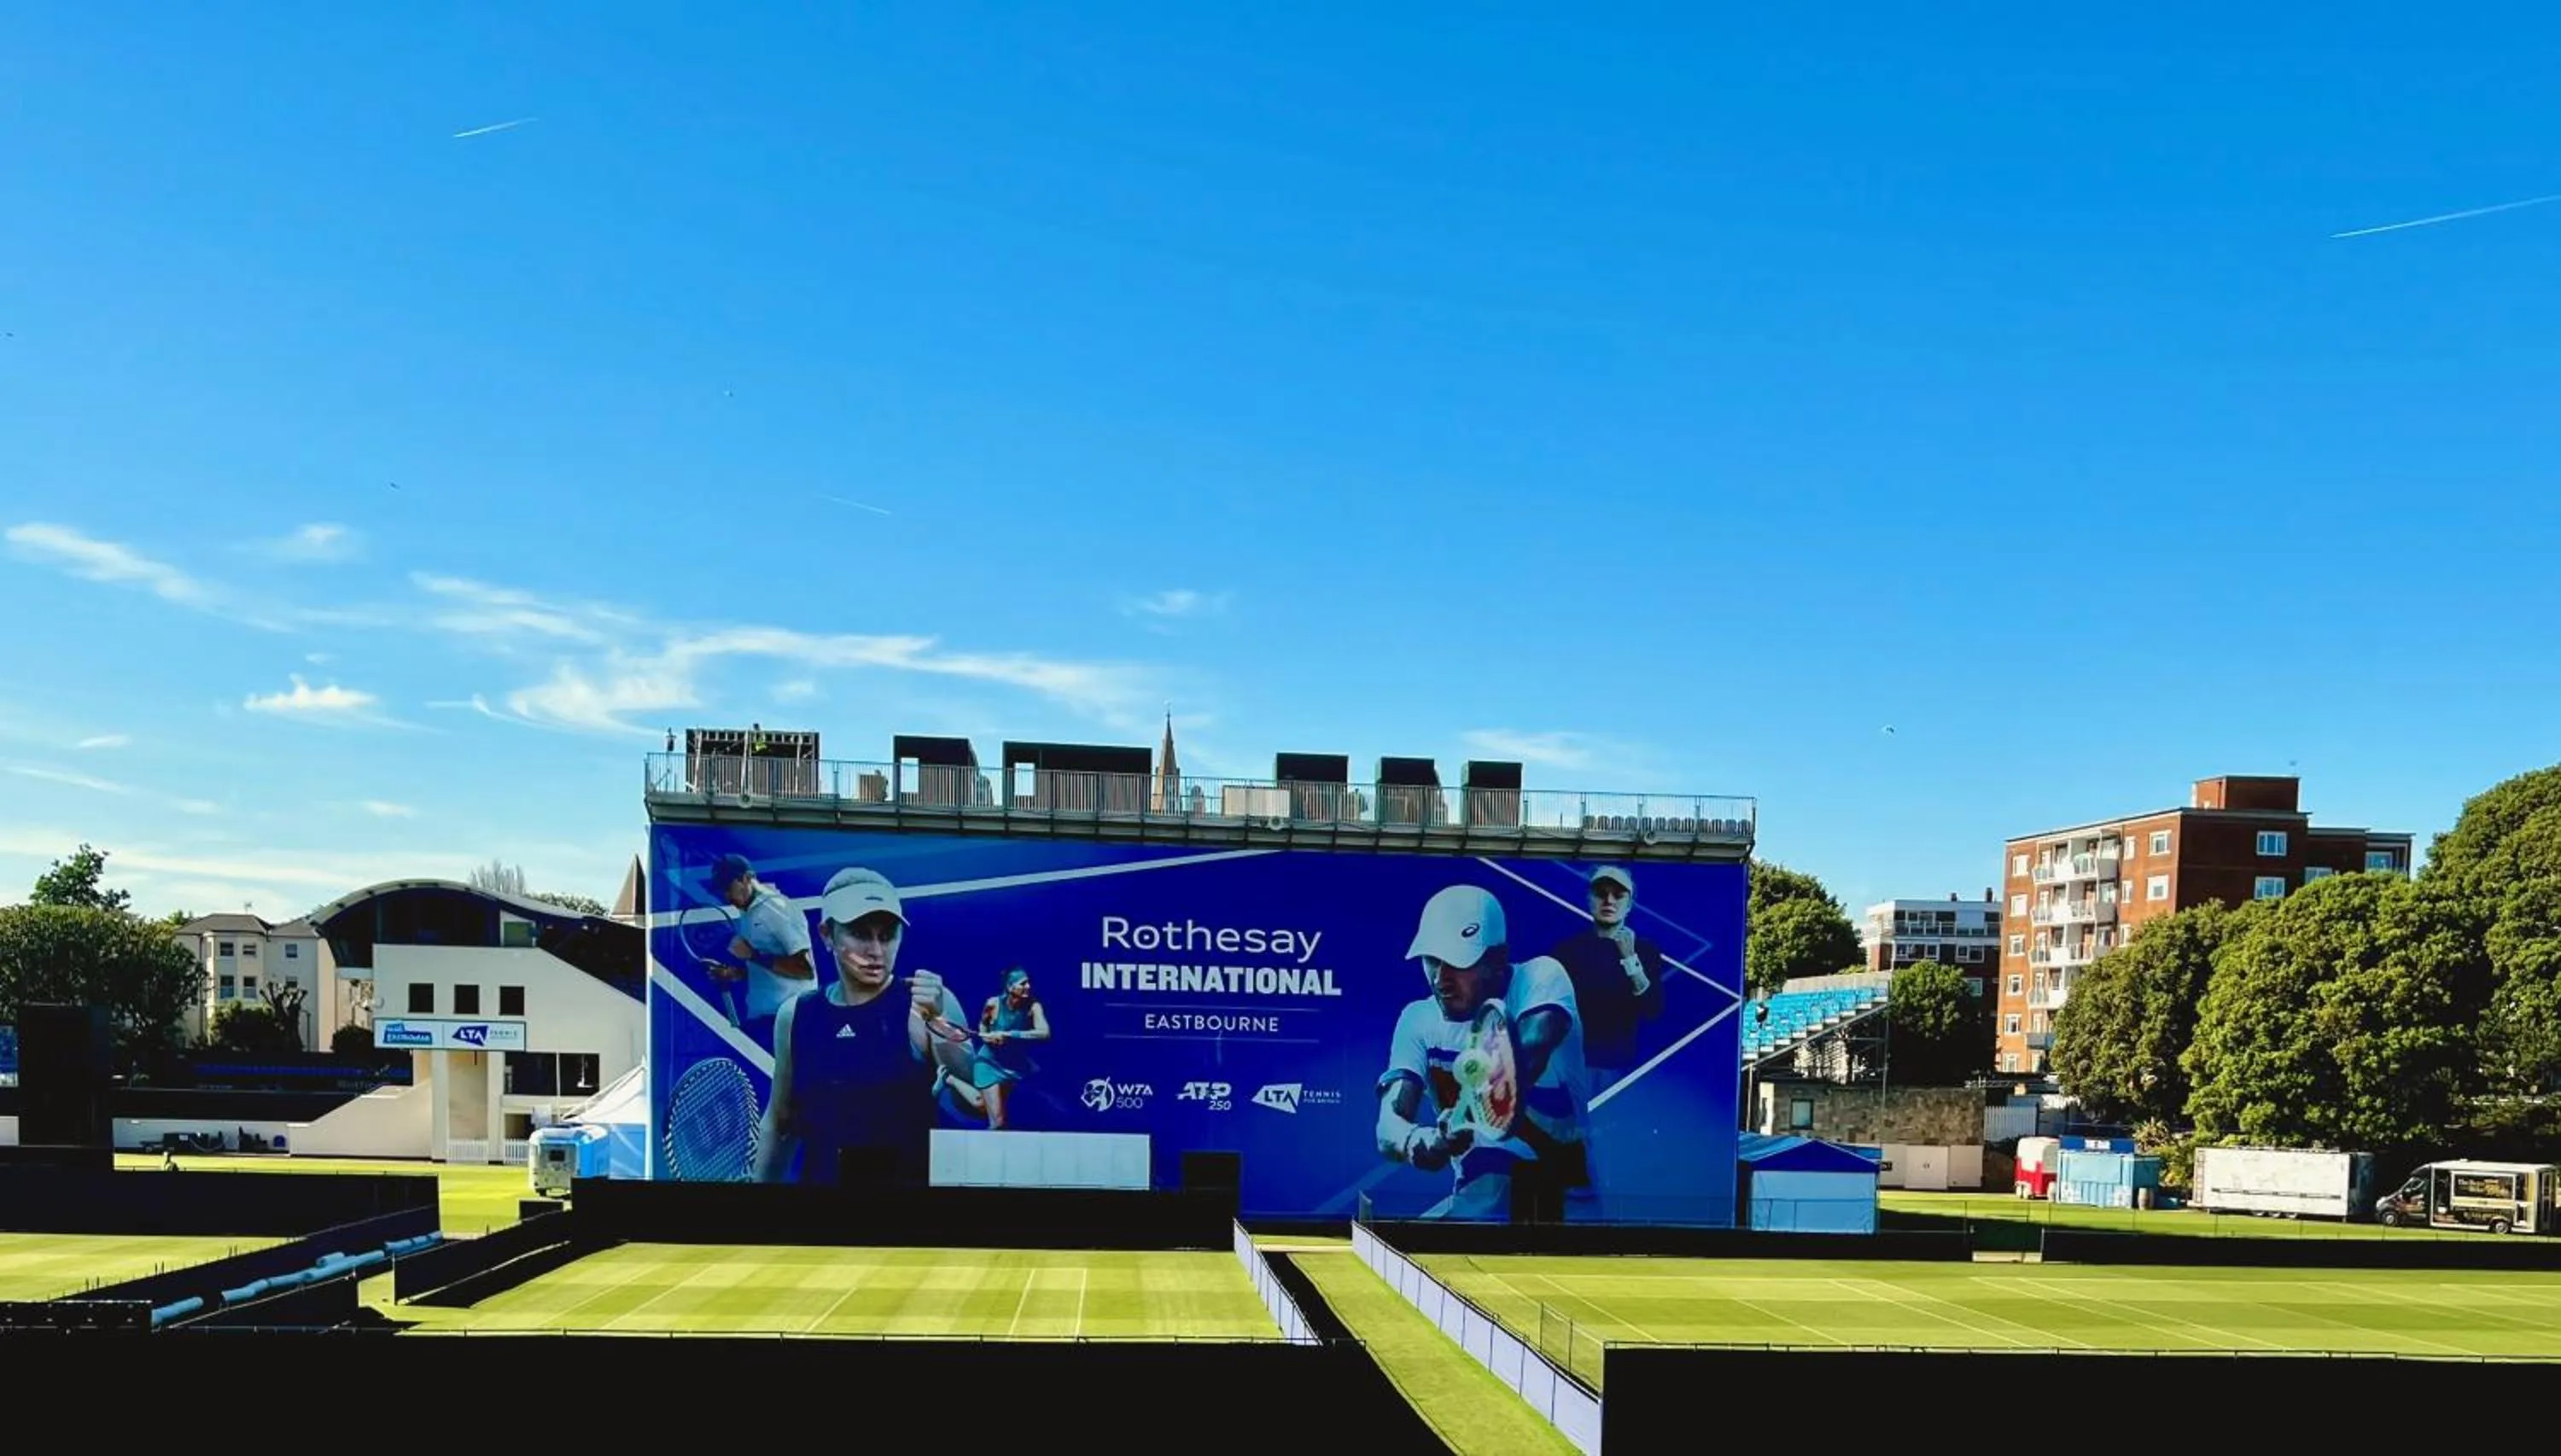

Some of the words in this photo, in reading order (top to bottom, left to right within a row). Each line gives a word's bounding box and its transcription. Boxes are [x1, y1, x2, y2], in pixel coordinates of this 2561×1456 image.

[1101, 916, 1322, 964] Rothesay
[1081, 962, 1343, 996] INTERNATIONAL
[1145, 1013, 1280, 1033] EASTBOURNE
[460, 1028, 485, 1041] LTA
[1117, 1083, 1153, 1096] WTA
[1176, 1081, 1233, 1100] ATP
[1303, 1090, 1341, 1098] TENNIS
[1116, 1096, 1144, 1109] 500
[1208, 1099, 1232, 1110] 250
[1264, 1090, 1298, 1108] LTA
